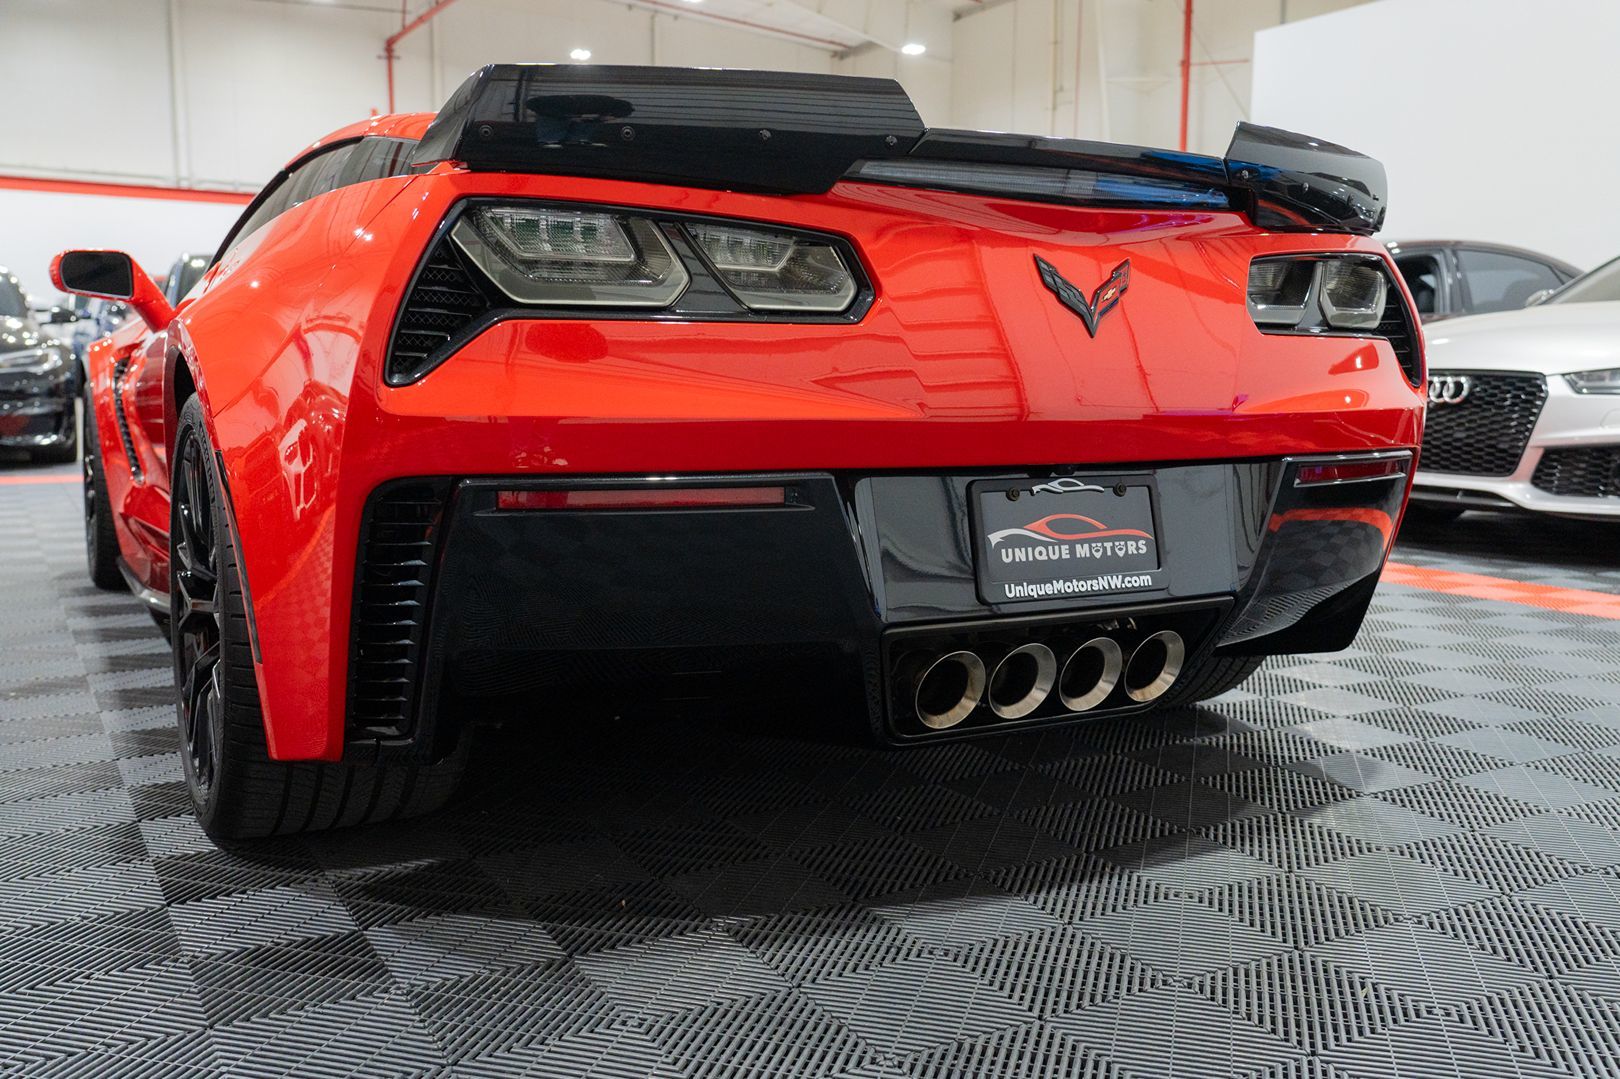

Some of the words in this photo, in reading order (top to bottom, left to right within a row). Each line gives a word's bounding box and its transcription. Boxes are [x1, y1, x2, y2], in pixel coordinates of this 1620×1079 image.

[1001, 544, 1070, 563] UNIQUE
[1075, 540, 1147, 559] MOTORS
[1004, 575, 1152, 598] UniqueMotorsNW.com
